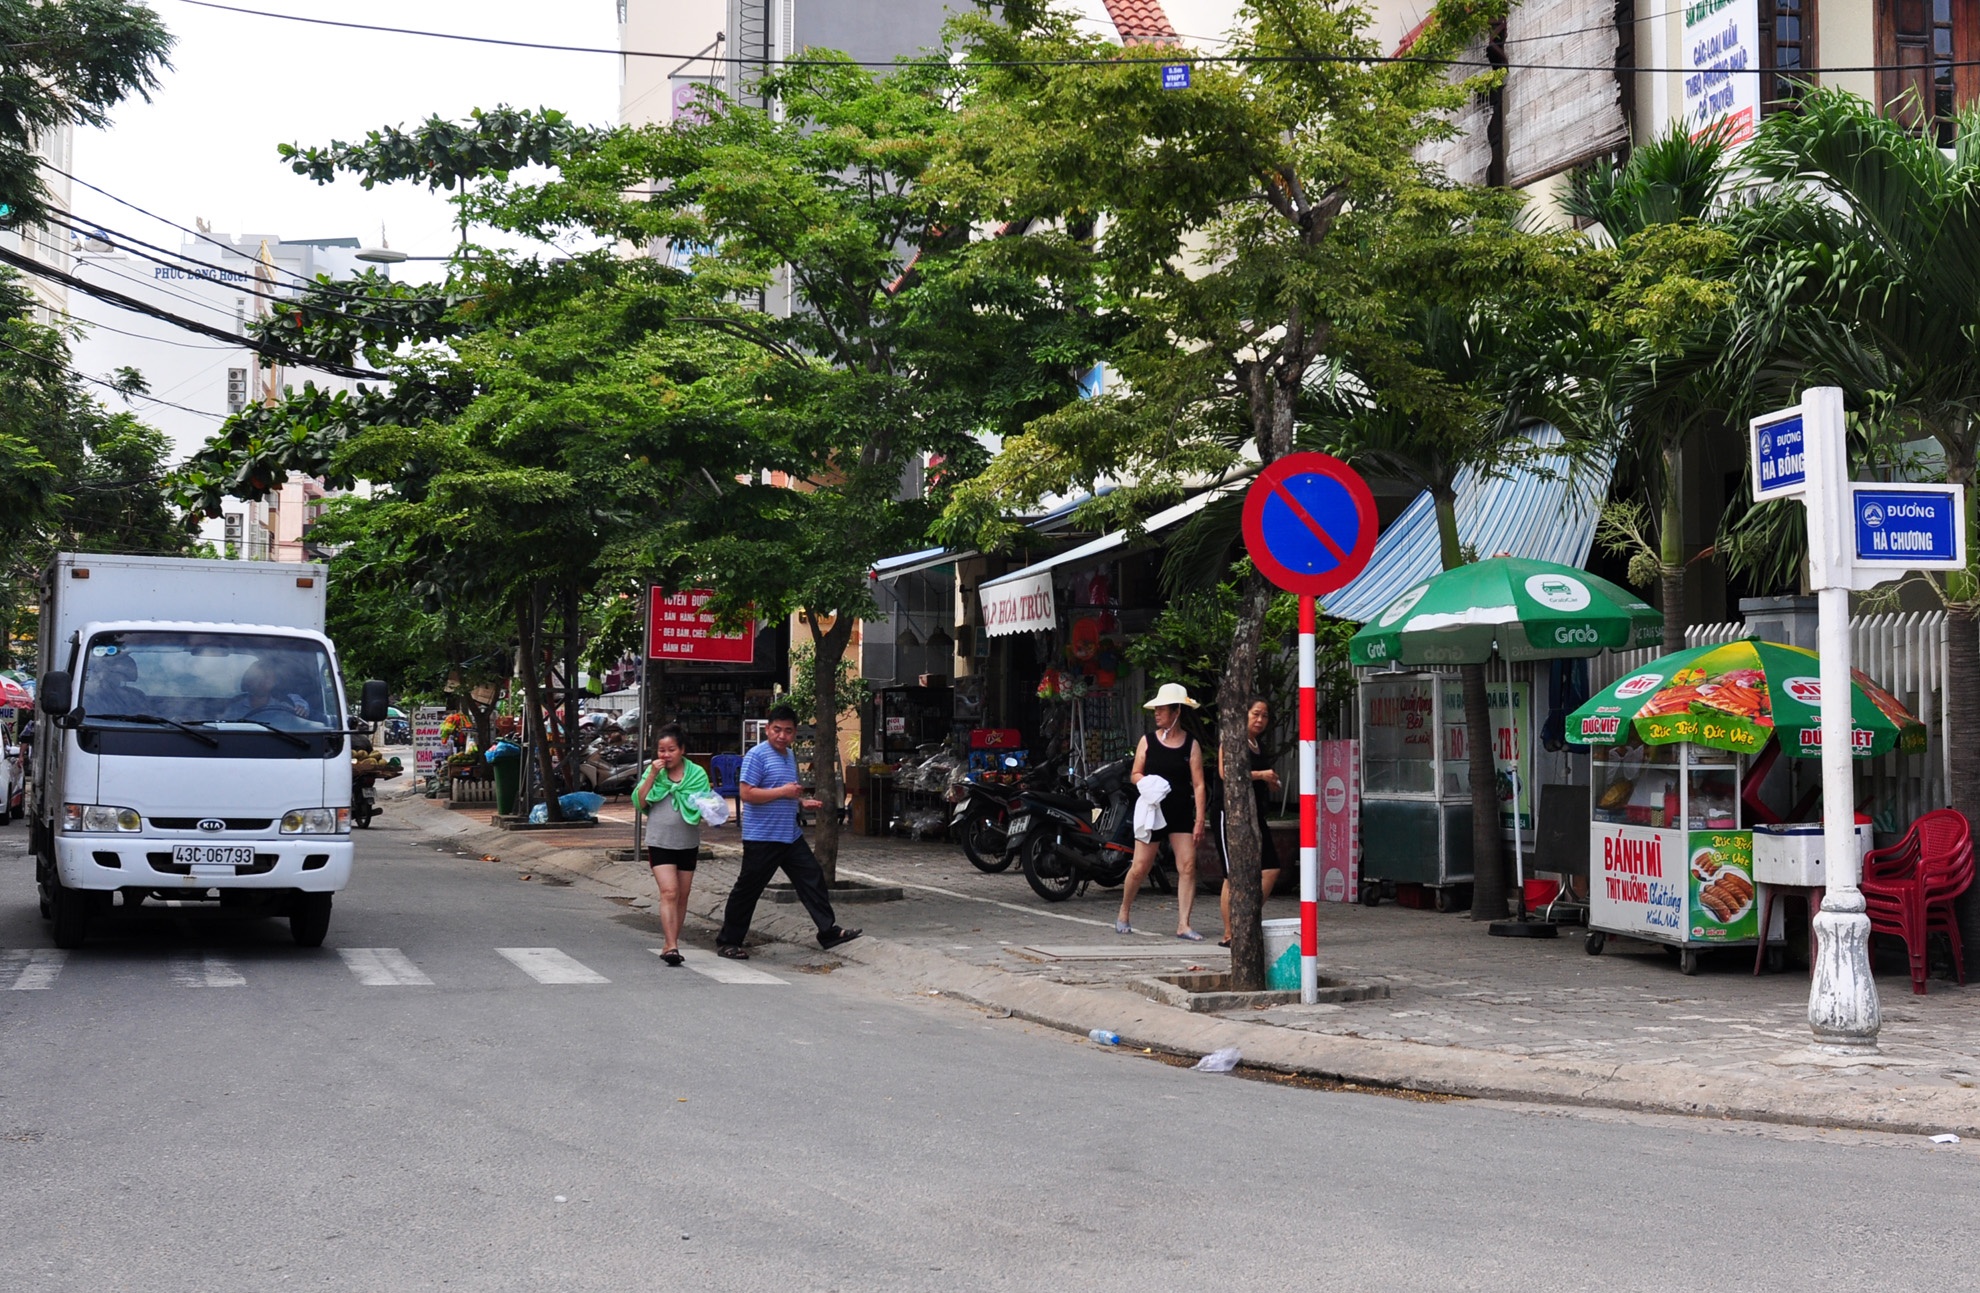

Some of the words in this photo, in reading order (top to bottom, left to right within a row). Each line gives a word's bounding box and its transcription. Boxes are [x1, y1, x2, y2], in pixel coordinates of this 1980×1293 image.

[1776, 429, 1802, 447] ĐƯỜNG
[1762, 451, 1776, 480] HÀ
[1887, 502, 1935, 519] ĐƯỜNG
[1873, 528, 1887, 550] HÀ
[1890, 530, 1934, 551] CHƯƠNG
[1020, 584, 1052, 621] TRÚC
[1555, 624, 1598, 644] Grab
[1367, 638, 1387, 659] Grab
[415, 712, 437, 721] CAFE
[1582, 717, 1600, 734] ĐỨC
[1601, 716, 1620, 737] VIỆT
[176, 847, 253, 864] 43C-067.93
[1604, 829, 1645, 876] BÁNH
[1646, 834, 1663, 878] MÌ
[1605, 873, 1621, 904] THỊT
